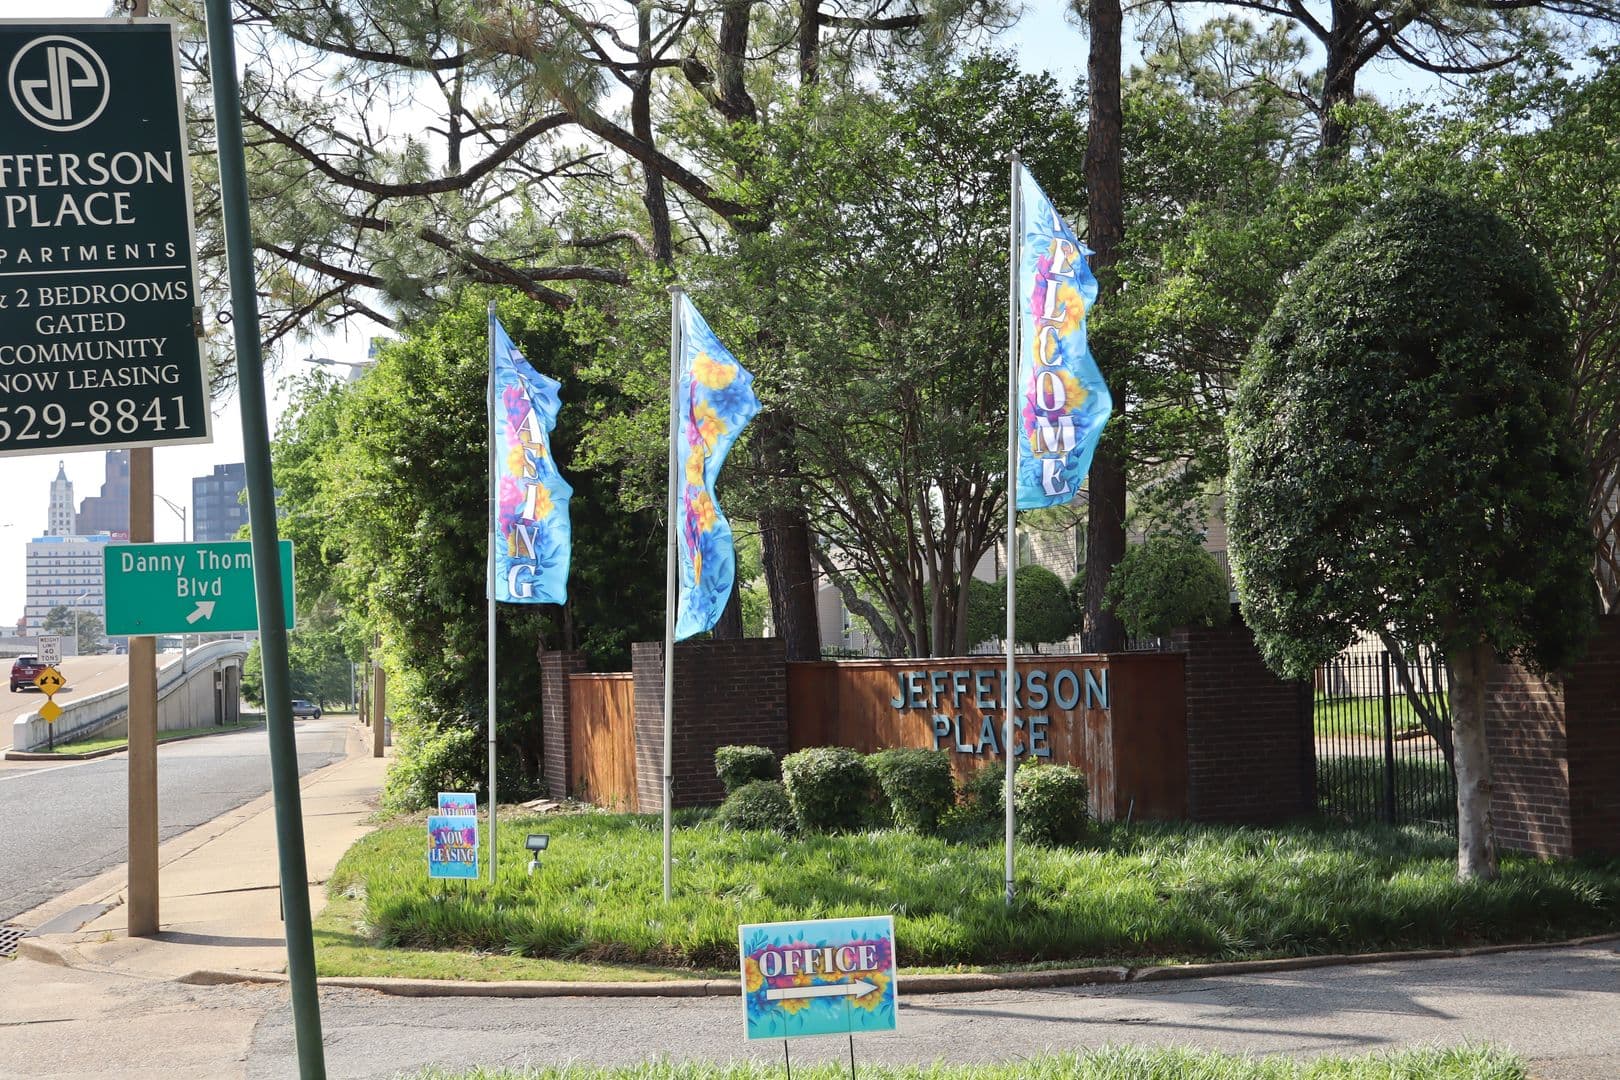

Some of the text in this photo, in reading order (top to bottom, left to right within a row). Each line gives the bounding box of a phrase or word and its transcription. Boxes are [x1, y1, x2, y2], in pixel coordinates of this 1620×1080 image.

[5, 192, 136, 228] PLACE
[16, 288, 31, 308] 2
[38, 281, 188, 307] BEDROOMS
[36, 312, 126, 335] GATED
[0, 338, 167, 366] COMMUNITY
[68, 364, 180, 390] LEASING
[507, 373, 544, 600] ASING
[121, 552, 186, 576] Danny
[177, 577, 222, 597] Blvd
[890, 668, 1110, 711] JEFFERSON
[931, 713, 1051, 757] PLACE
[440, 831, 465, 845] NOW
[431, 848, 474, 862] LEASING
[759, 944, 878, 977] OFFICE
